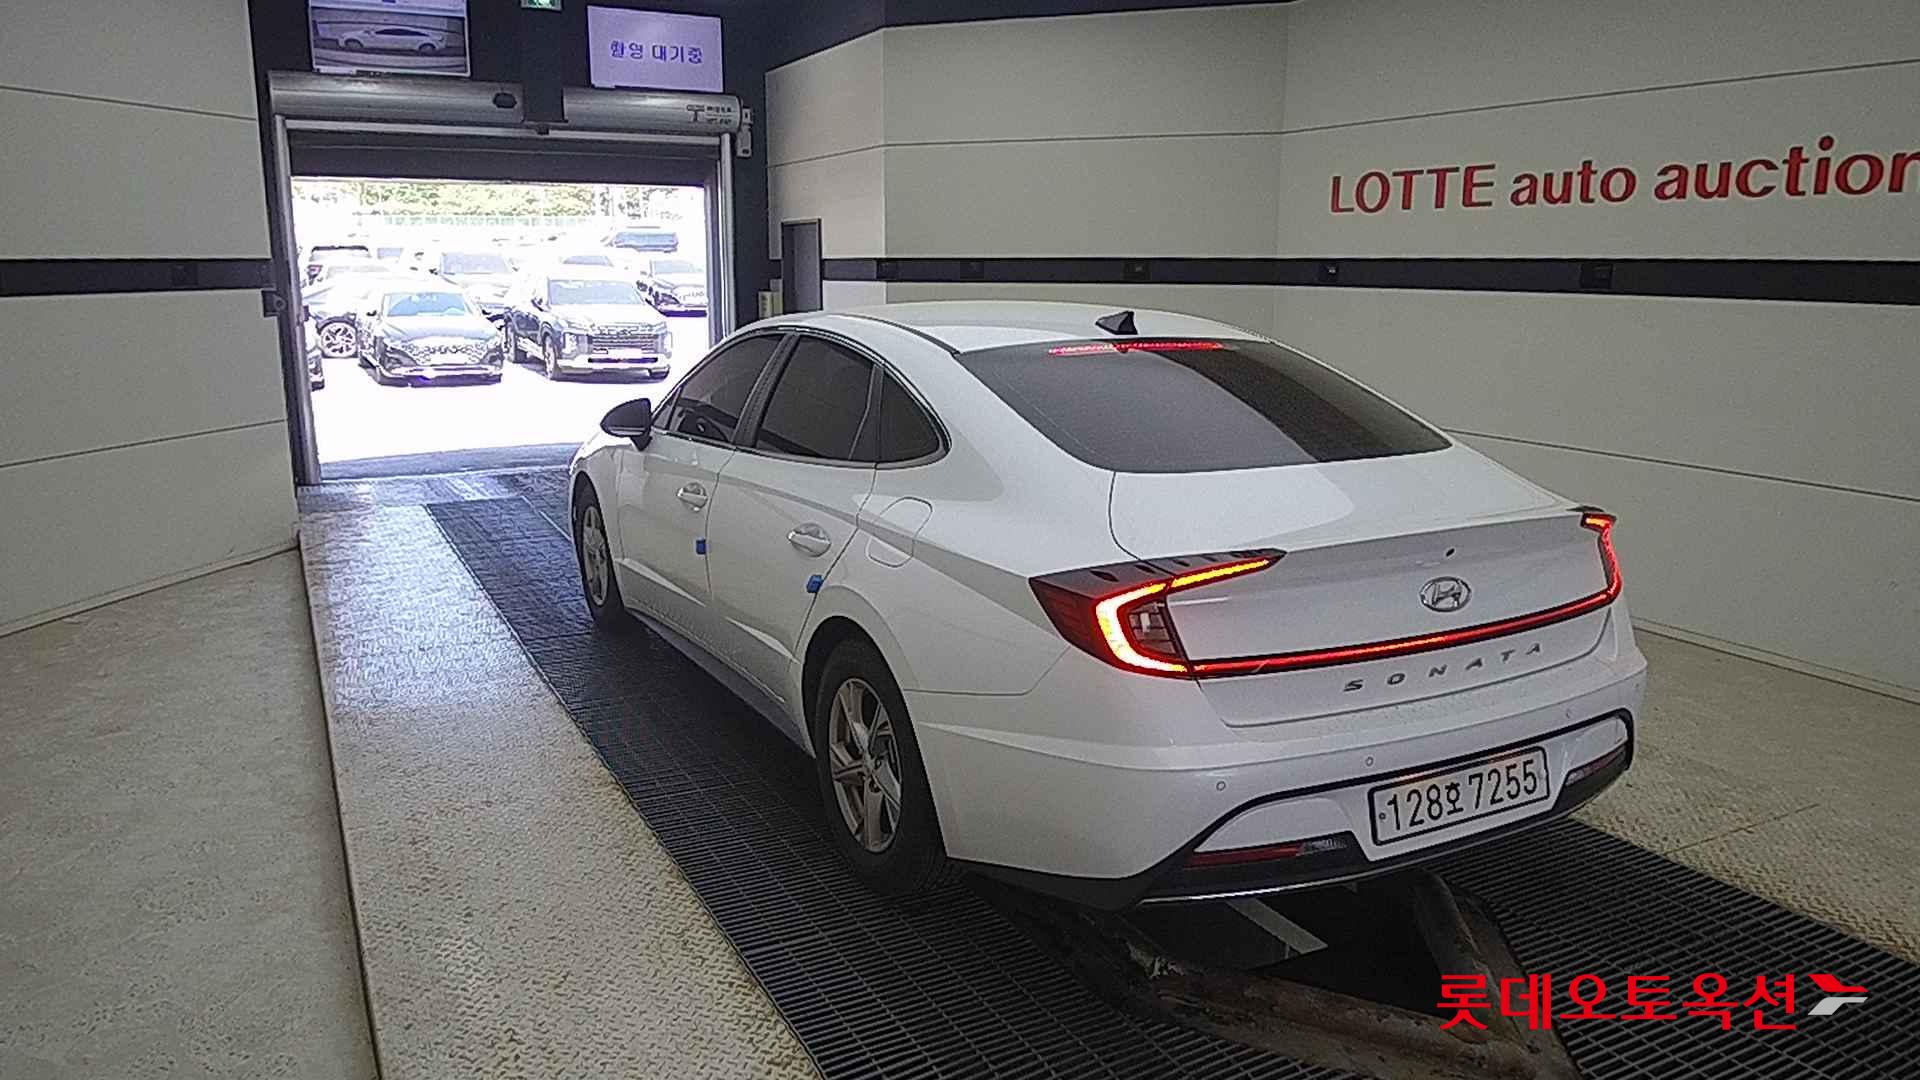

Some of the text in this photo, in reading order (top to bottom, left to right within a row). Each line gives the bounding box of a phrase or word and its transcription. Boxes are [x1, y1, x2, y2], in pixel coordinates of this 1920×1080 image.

[652, 44, 703, 65] 대기중
[1330, 163, 1496, 213] LOTTE
[1509, 160, 1636, 206] auto
[1344, 642, 1542, 692] SONATA
[1467, 758, 1538, 810] 7255
